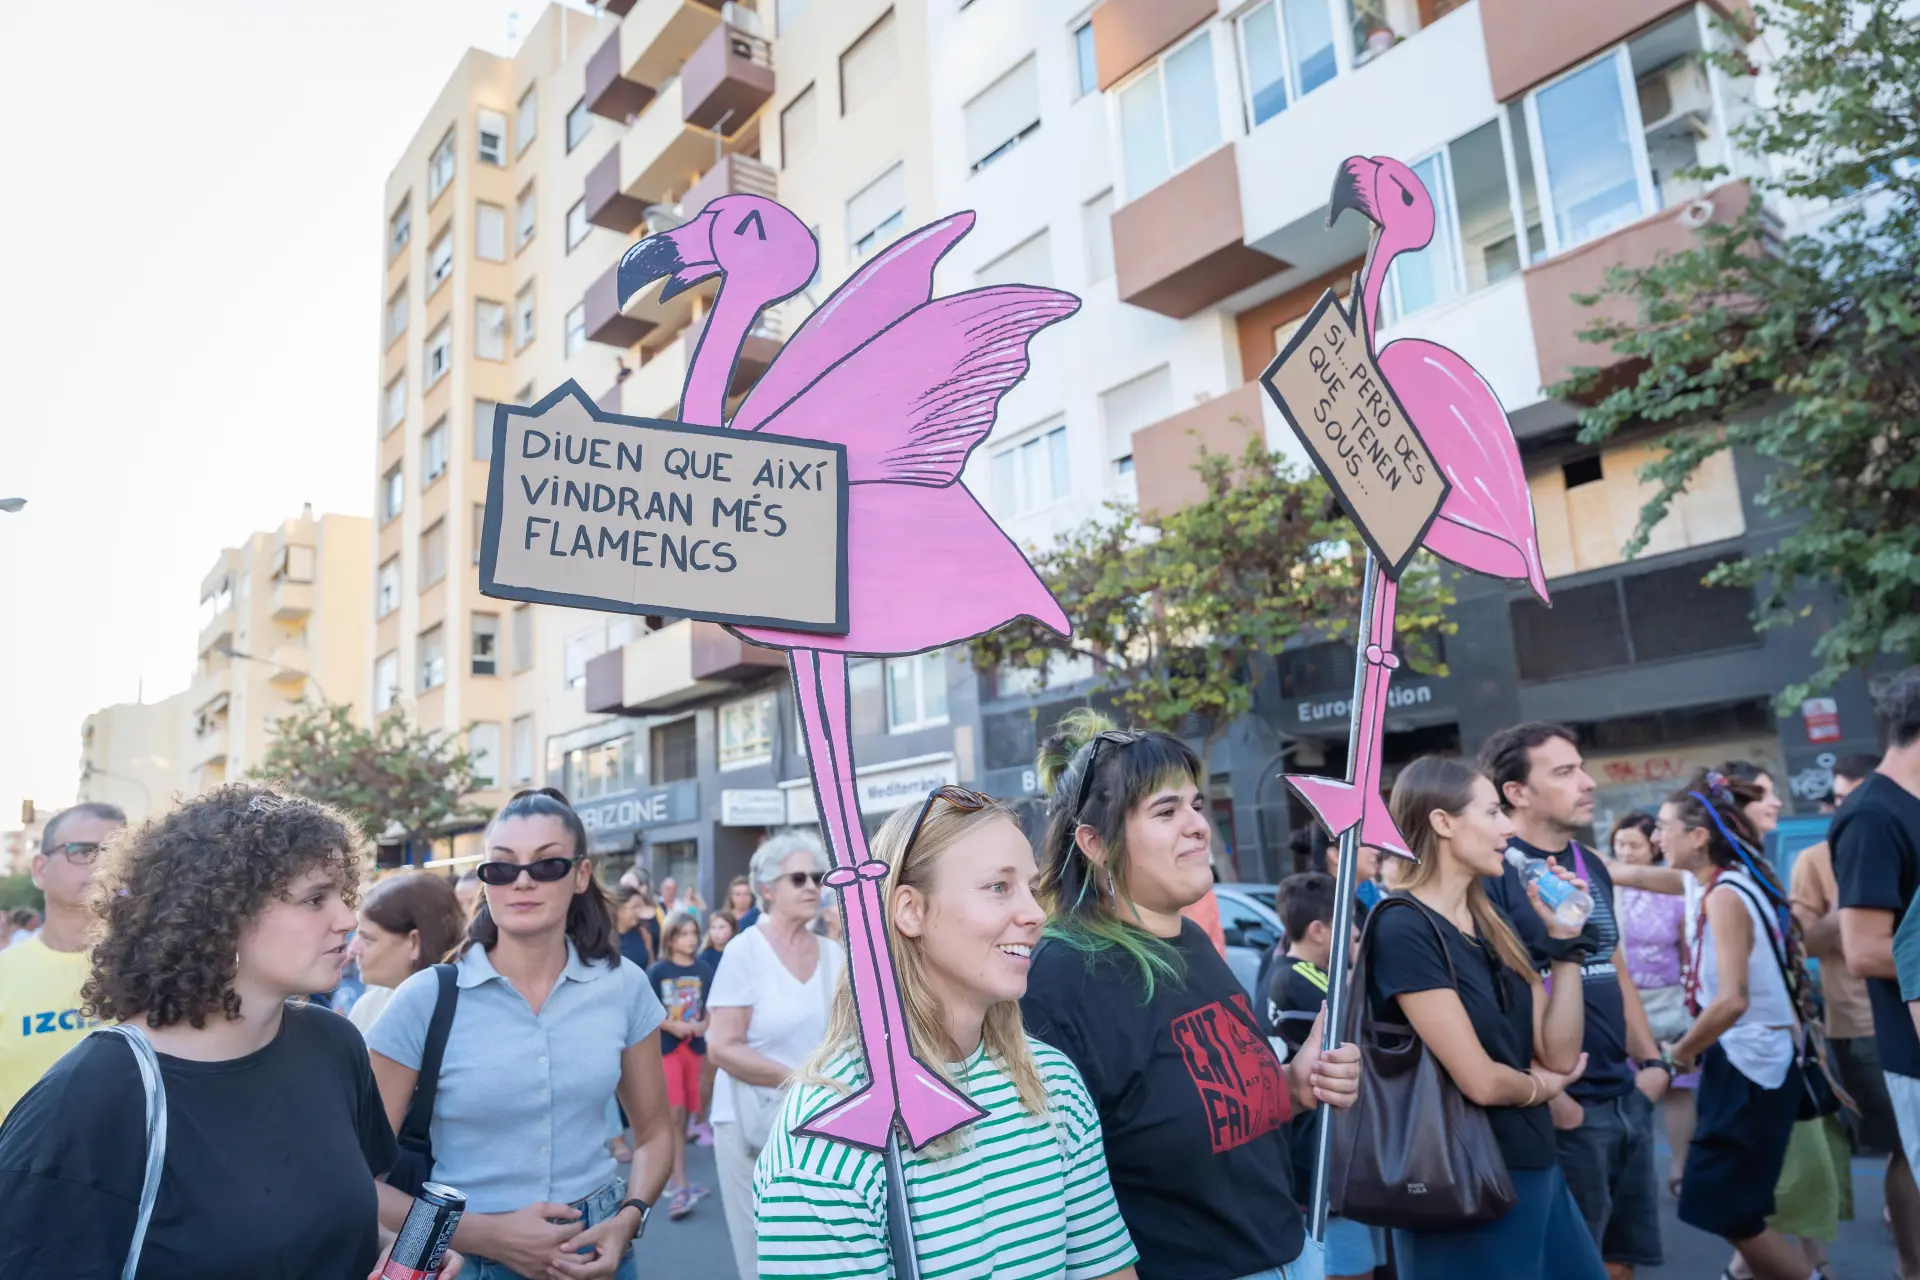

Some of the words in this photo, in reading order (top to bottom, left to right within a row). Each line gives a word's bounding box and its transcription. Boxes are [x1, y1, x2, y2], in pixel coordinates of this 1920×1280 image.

[1309, 345, 1346, 402] QUE
[1350, 408, 1402, 492] TENEN
[1349, 362, 1392, 428] PERÒ
[1394, 434, 1425, 486] DES
[664, 446, 733, 482] QUE
[524, 515, 739, 574] FLAMENCS
[711, 492, 788, 538] MÉS
